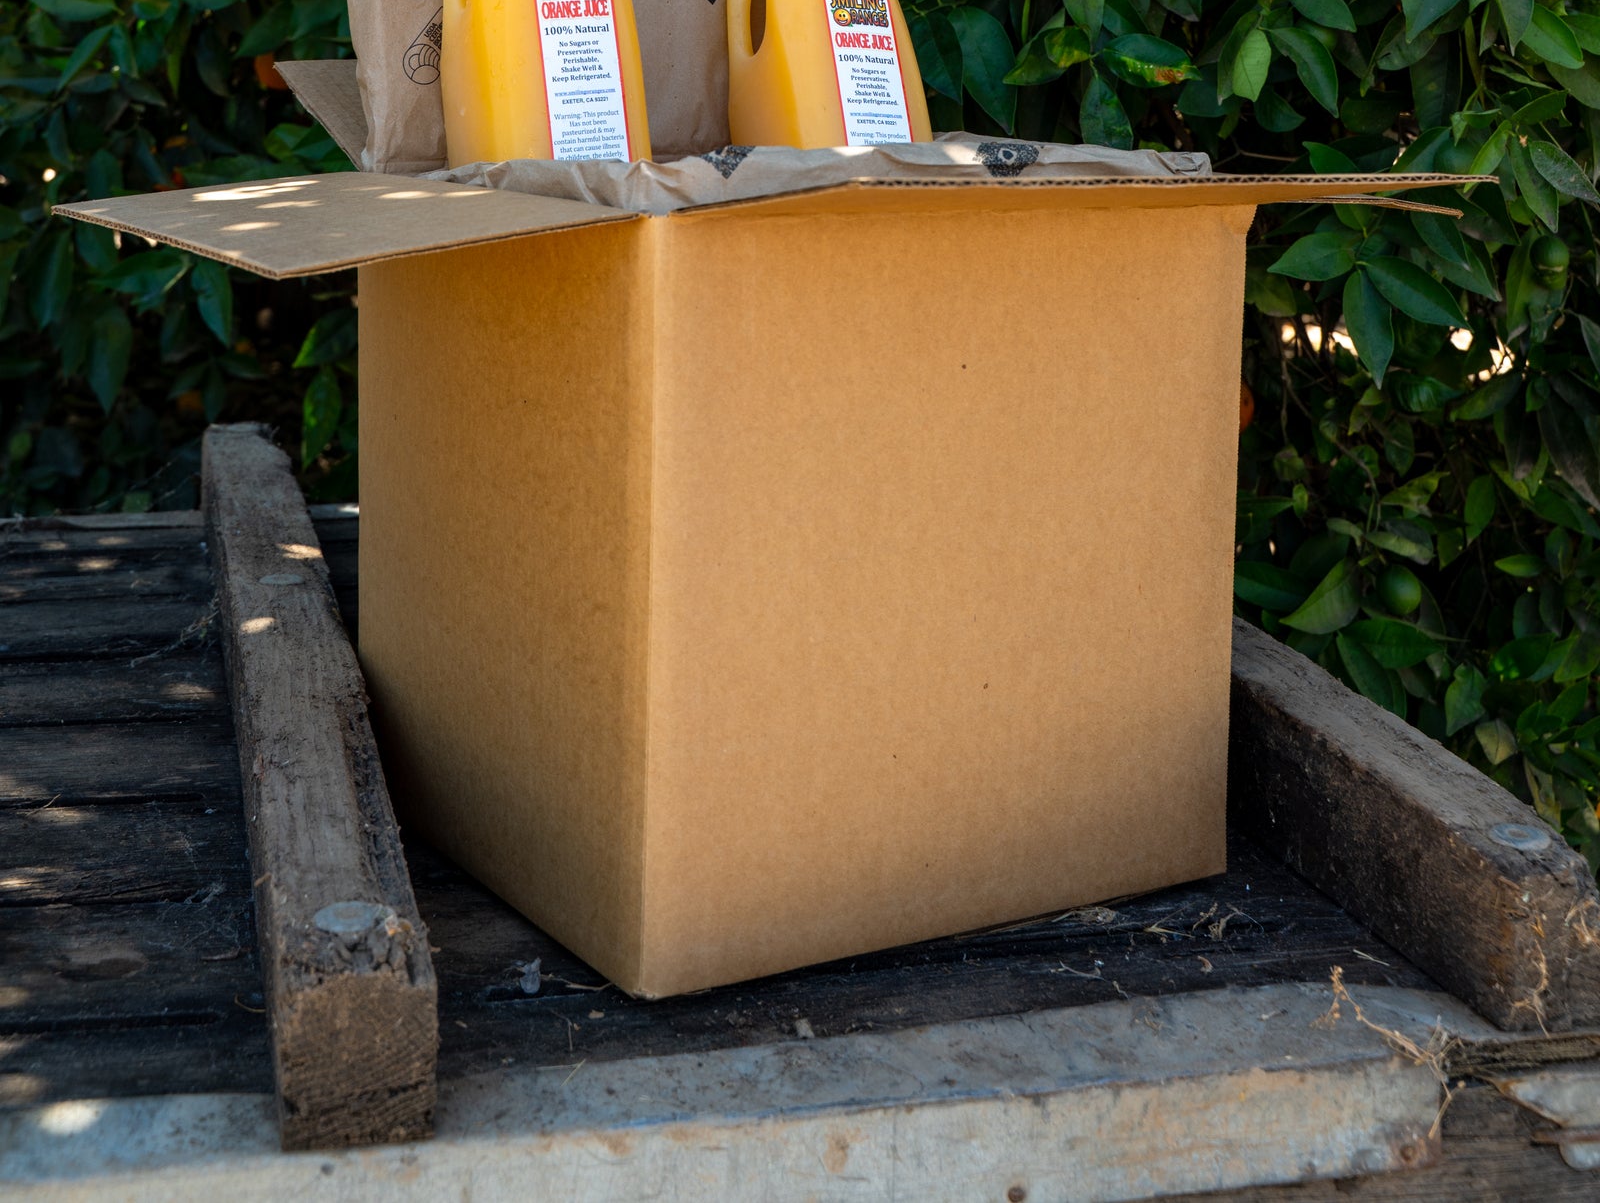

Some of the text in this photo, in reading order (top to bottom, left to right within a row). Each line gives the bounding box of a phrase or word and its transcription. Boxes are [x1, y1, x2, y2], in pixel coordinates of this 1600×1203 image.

[541, 0, 609, 19] ORANGE JUICE
[424, 23, 437, 37] USDA
[544, 24, 610, 36] 100% Natural
[835, 32, 894, 51] ORANGE JUICE
[557, 48, 603, 56] Preservatives,
[839, 54, 895, 66] 100% Natural
[570, 73, 612, 81] Refrigerated.
[597, 110, 619, 118] product
[562, 129, 596, 138] pasteurized
[578, 136, 601, 144] harmful
